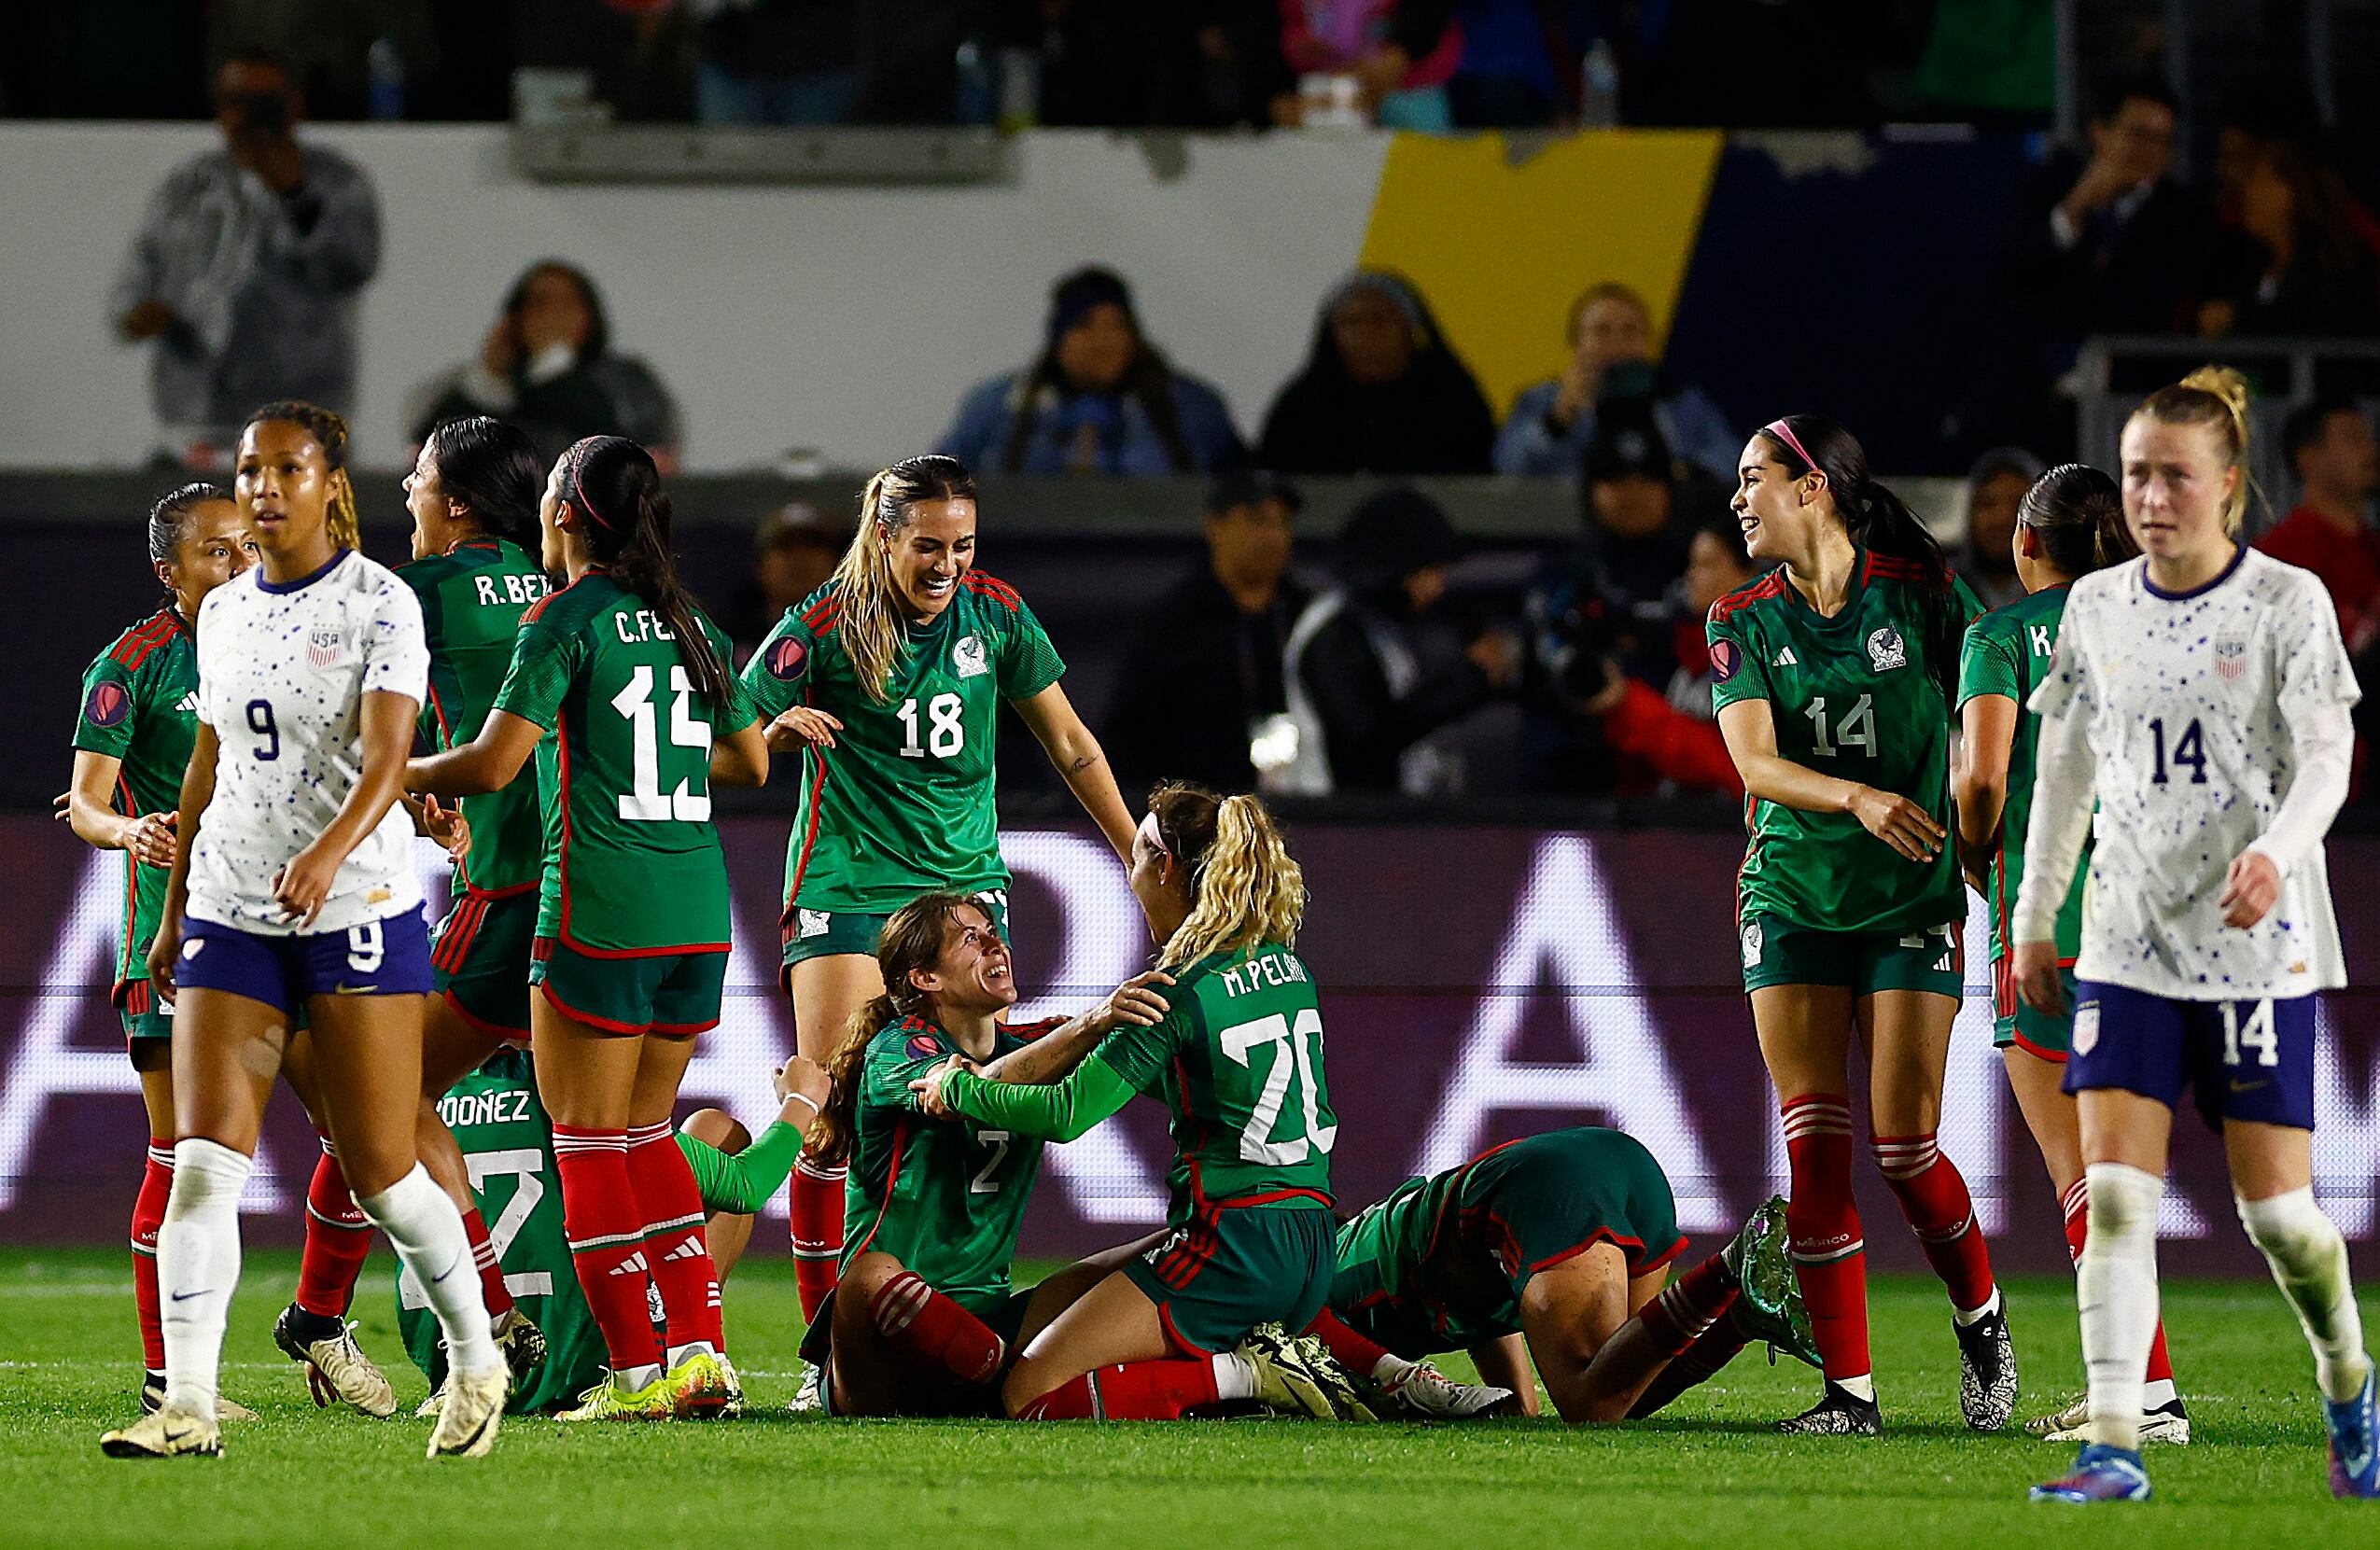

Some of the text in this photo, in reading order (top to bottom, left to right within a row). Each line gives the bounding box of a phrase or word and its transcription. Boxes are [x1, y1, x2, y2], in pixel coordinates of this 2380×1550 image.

[311, 632, 339, 648] USA
[246, 699, 280, 761] 9
[610, 665, 712, 822] 15
[896, 692, 965, 759] 18
[1804, 693, 1878, 758] 14
[2149, 717, 2207, 784] 14
[347, 920, 385, 973] 9
[2218, 998, 2279, 1067] 14
[1220, 1008, 1337, 1166] 20
[971, 1130, 1010, 1193] 2
